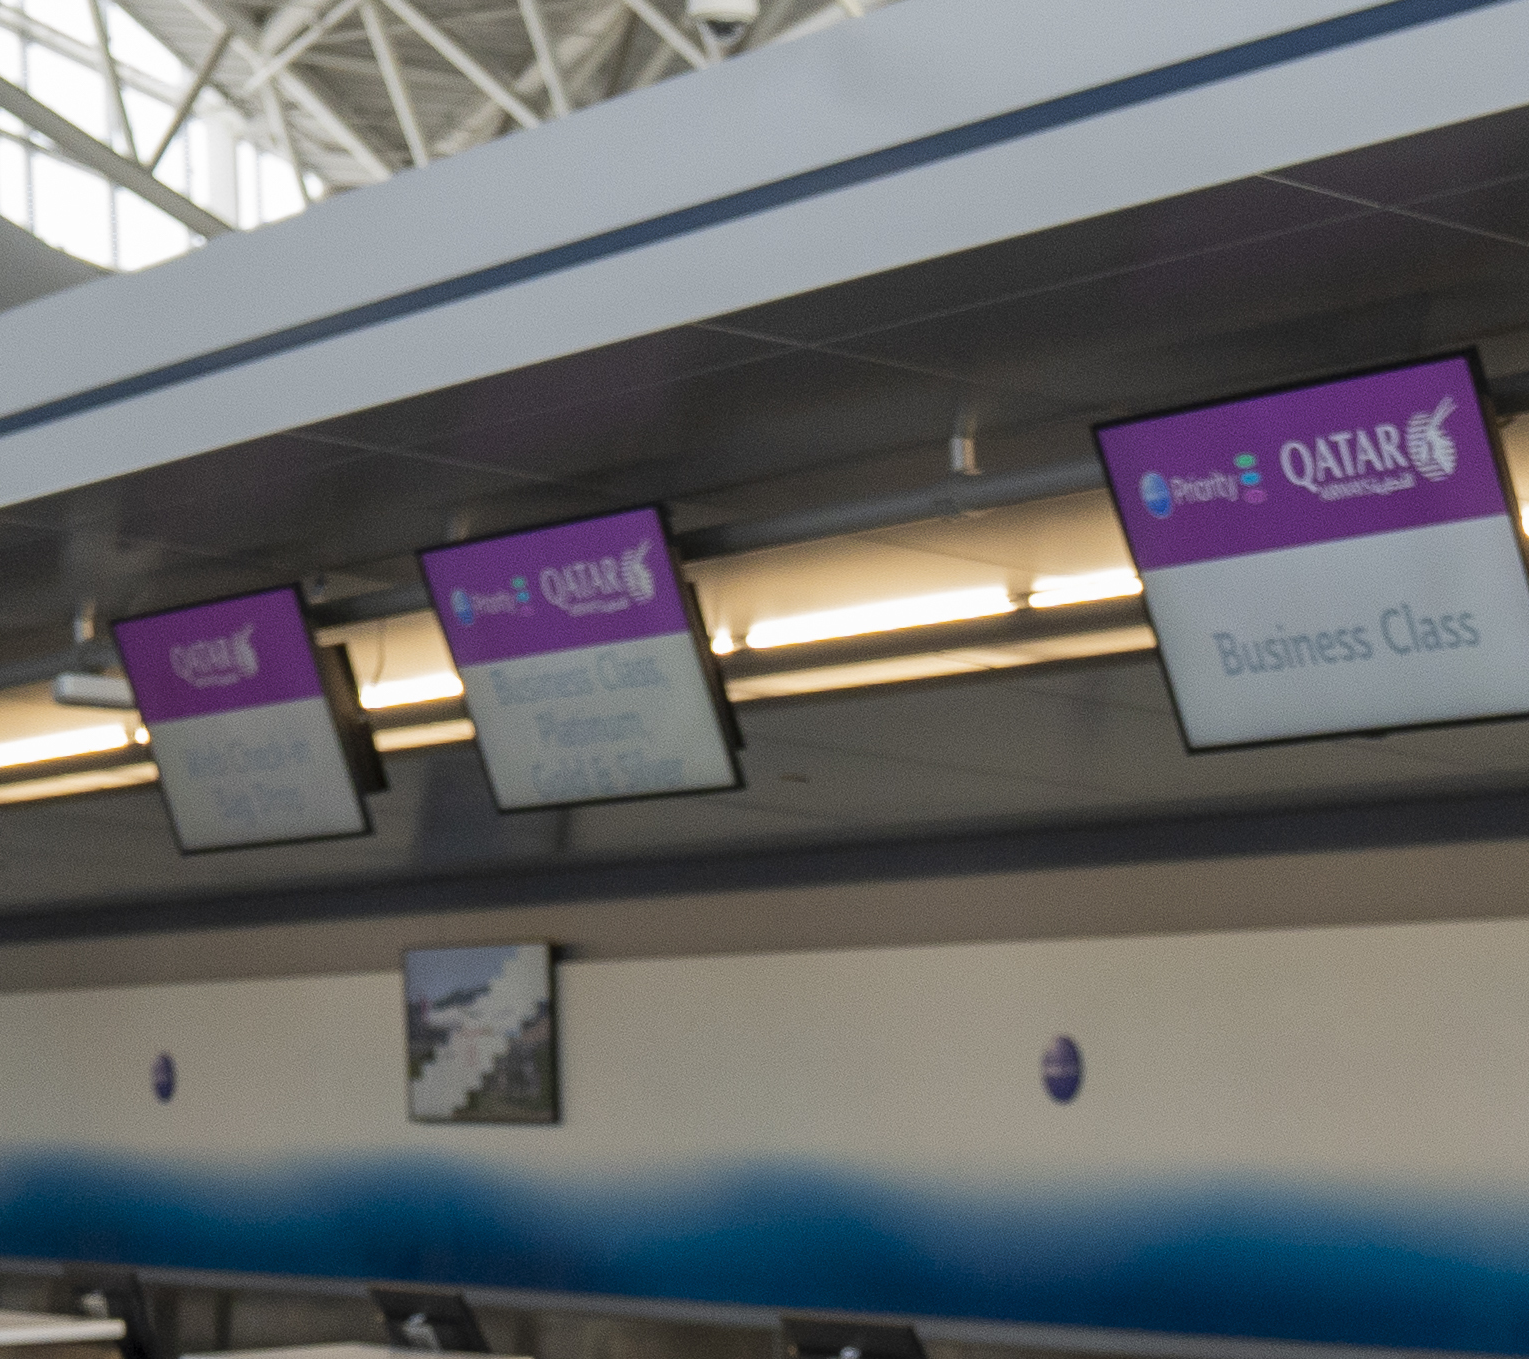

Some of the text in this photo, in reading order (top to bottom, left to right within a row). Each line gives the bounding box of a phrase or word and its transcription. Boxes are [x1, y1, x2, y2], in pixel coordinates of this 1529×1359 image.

[1279, 424, 1410, 494] QATAR
[1212, 602, 1480, 678] Business Class
